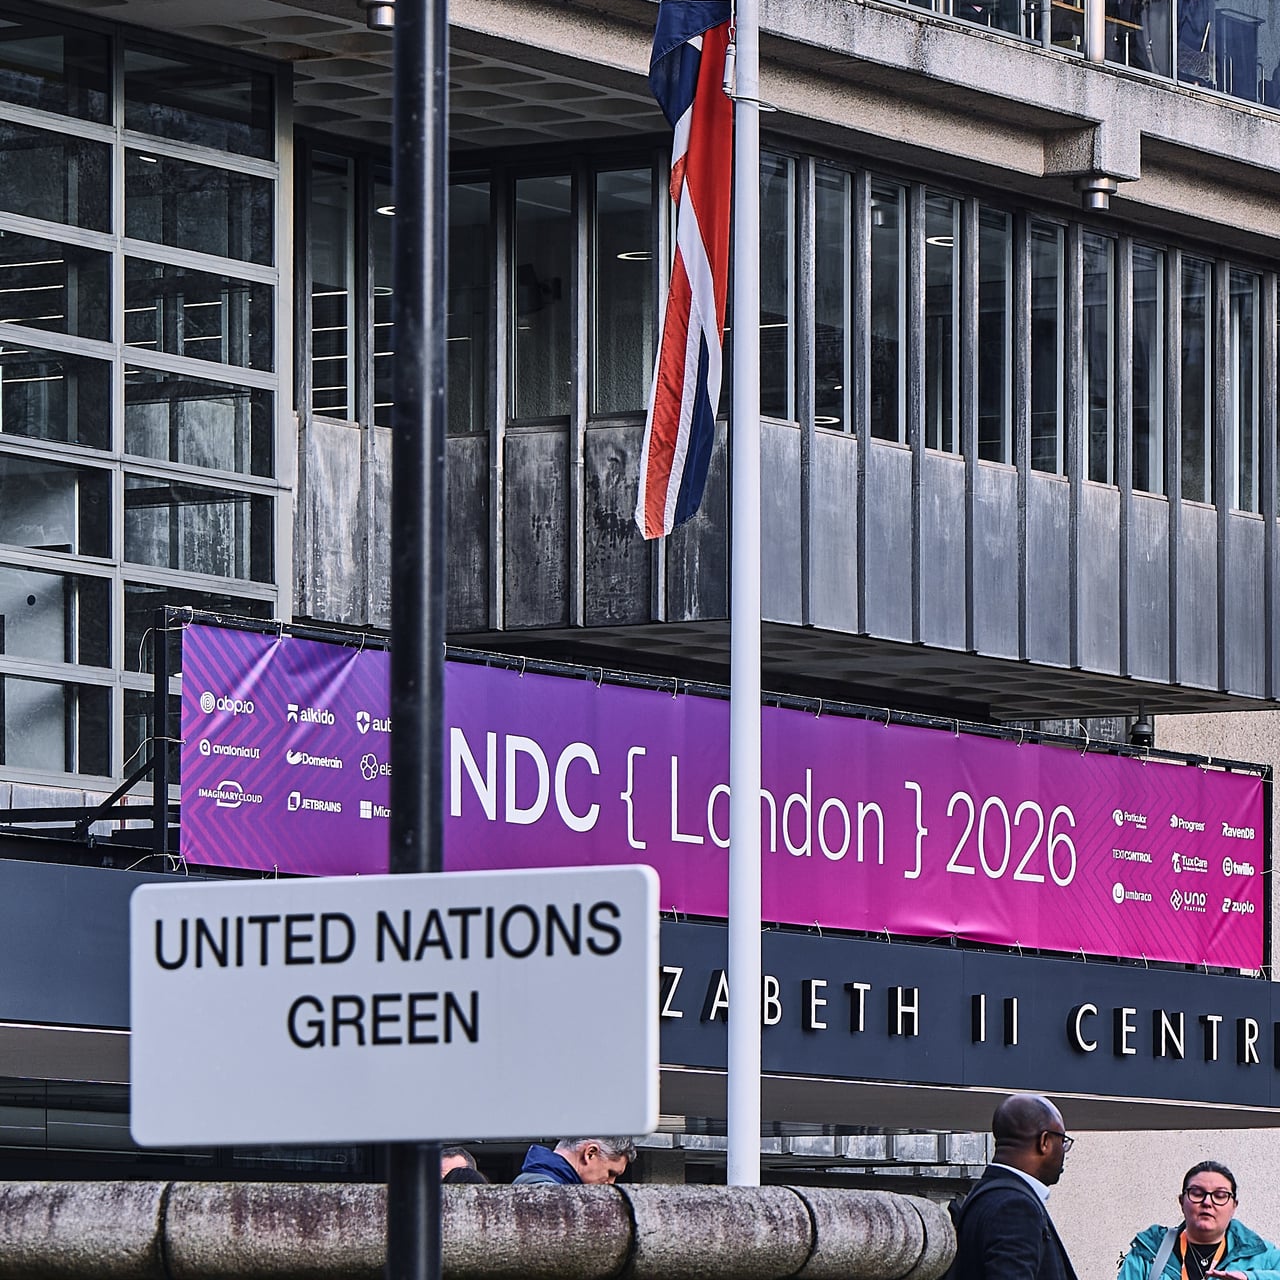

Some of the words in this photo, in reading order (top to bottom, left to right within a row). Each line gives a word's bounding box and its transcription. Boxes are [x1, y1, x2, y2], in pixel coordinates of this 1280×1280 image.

[217, 696, 254, 716] abp.io
[300, 707, 335, 725] aikido
[373, 717, 391, 732] aut
[302, 752, 343, 769] Dometrain
[302, 798, 342, 813] JETBRAINS
[450, 727, 600, 832] NDC
[671, 756, 884, 865] London
[946, 792, 1076, 886] 2026
[1222, 822, 1255, 840] RavenDB
[1125, 890, 1153, 902] umbraco
[1231, 900, 1255, 916] zuplo
[155, 912, 356, 971] UNITED
[377, 901, 622, 963] NATIONS
[661, 966, 919, 1036] ZABETH
[288, 991, 479, 1049] GREEN
